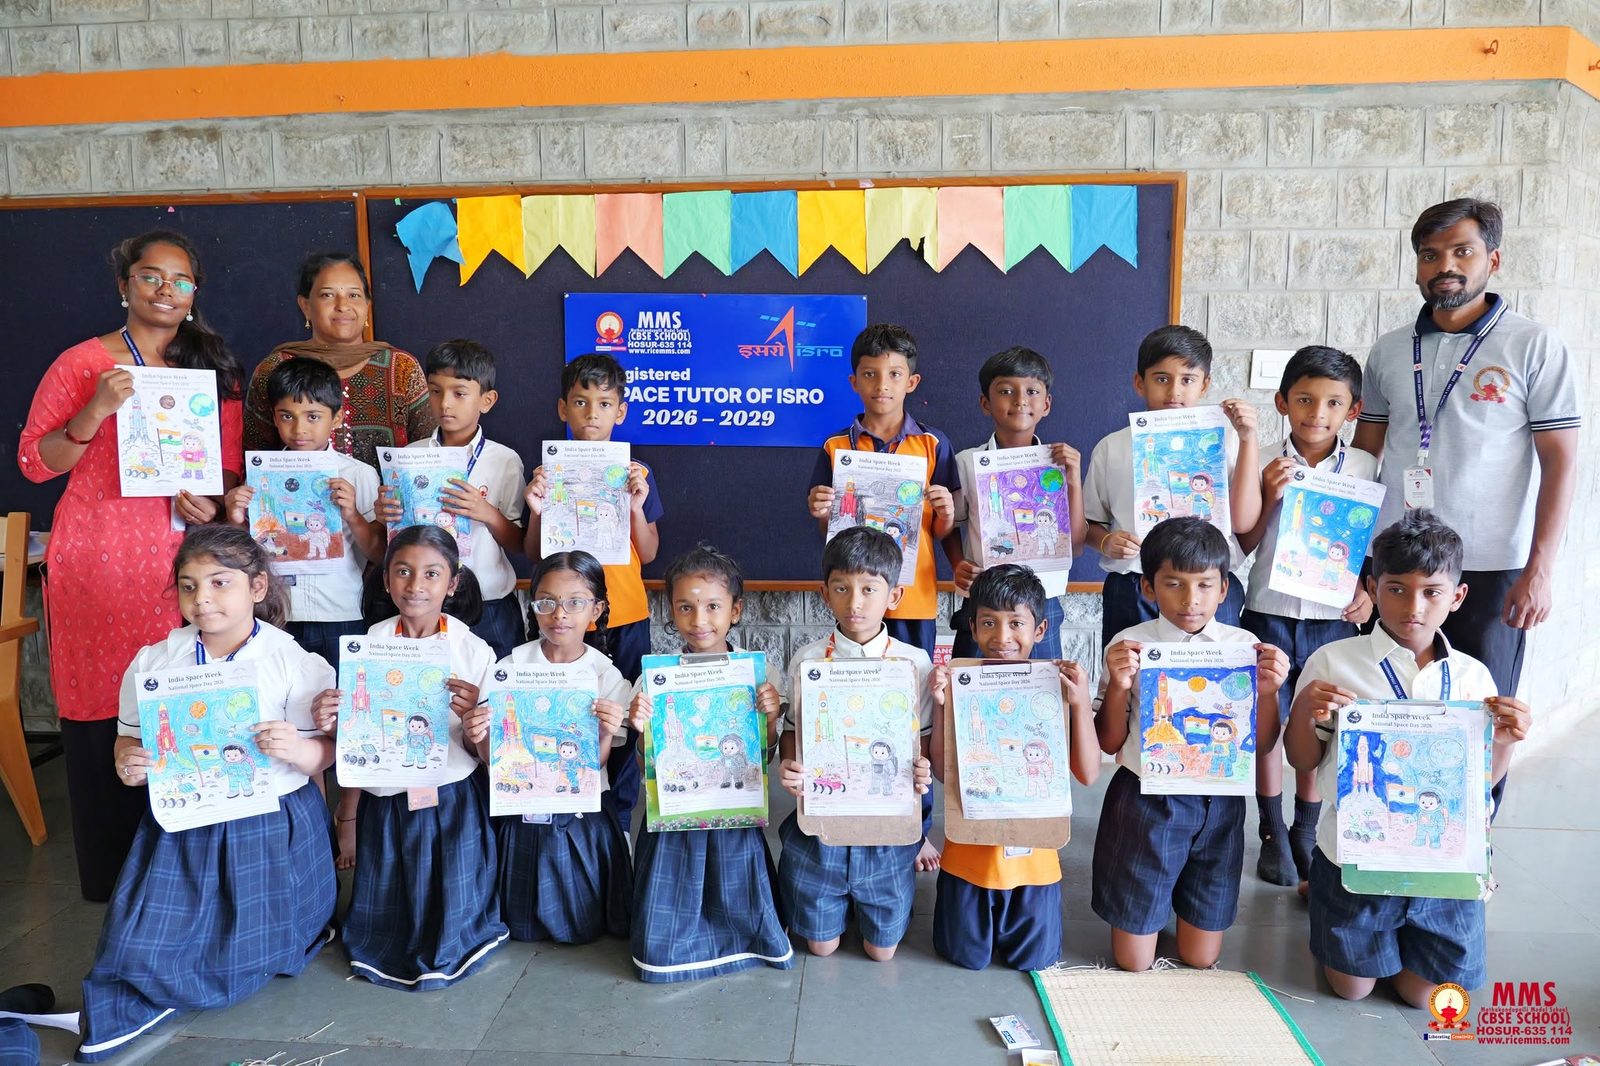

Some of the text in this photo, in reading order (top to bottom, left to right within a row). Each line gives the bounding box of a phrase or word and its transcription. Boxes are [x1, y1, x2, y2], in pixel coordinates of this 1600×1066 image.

[638, 311, 681, 329] MMS
[628, 331, 691, 342] (CBSE SCHOOL)
[625, 366, 691, 383] gistered
[624, 387, 824, 404] ACE TUTOR OF ISRO
[642, 409, 697, 425] 2026
[719, 410, 775, 426] 2029
